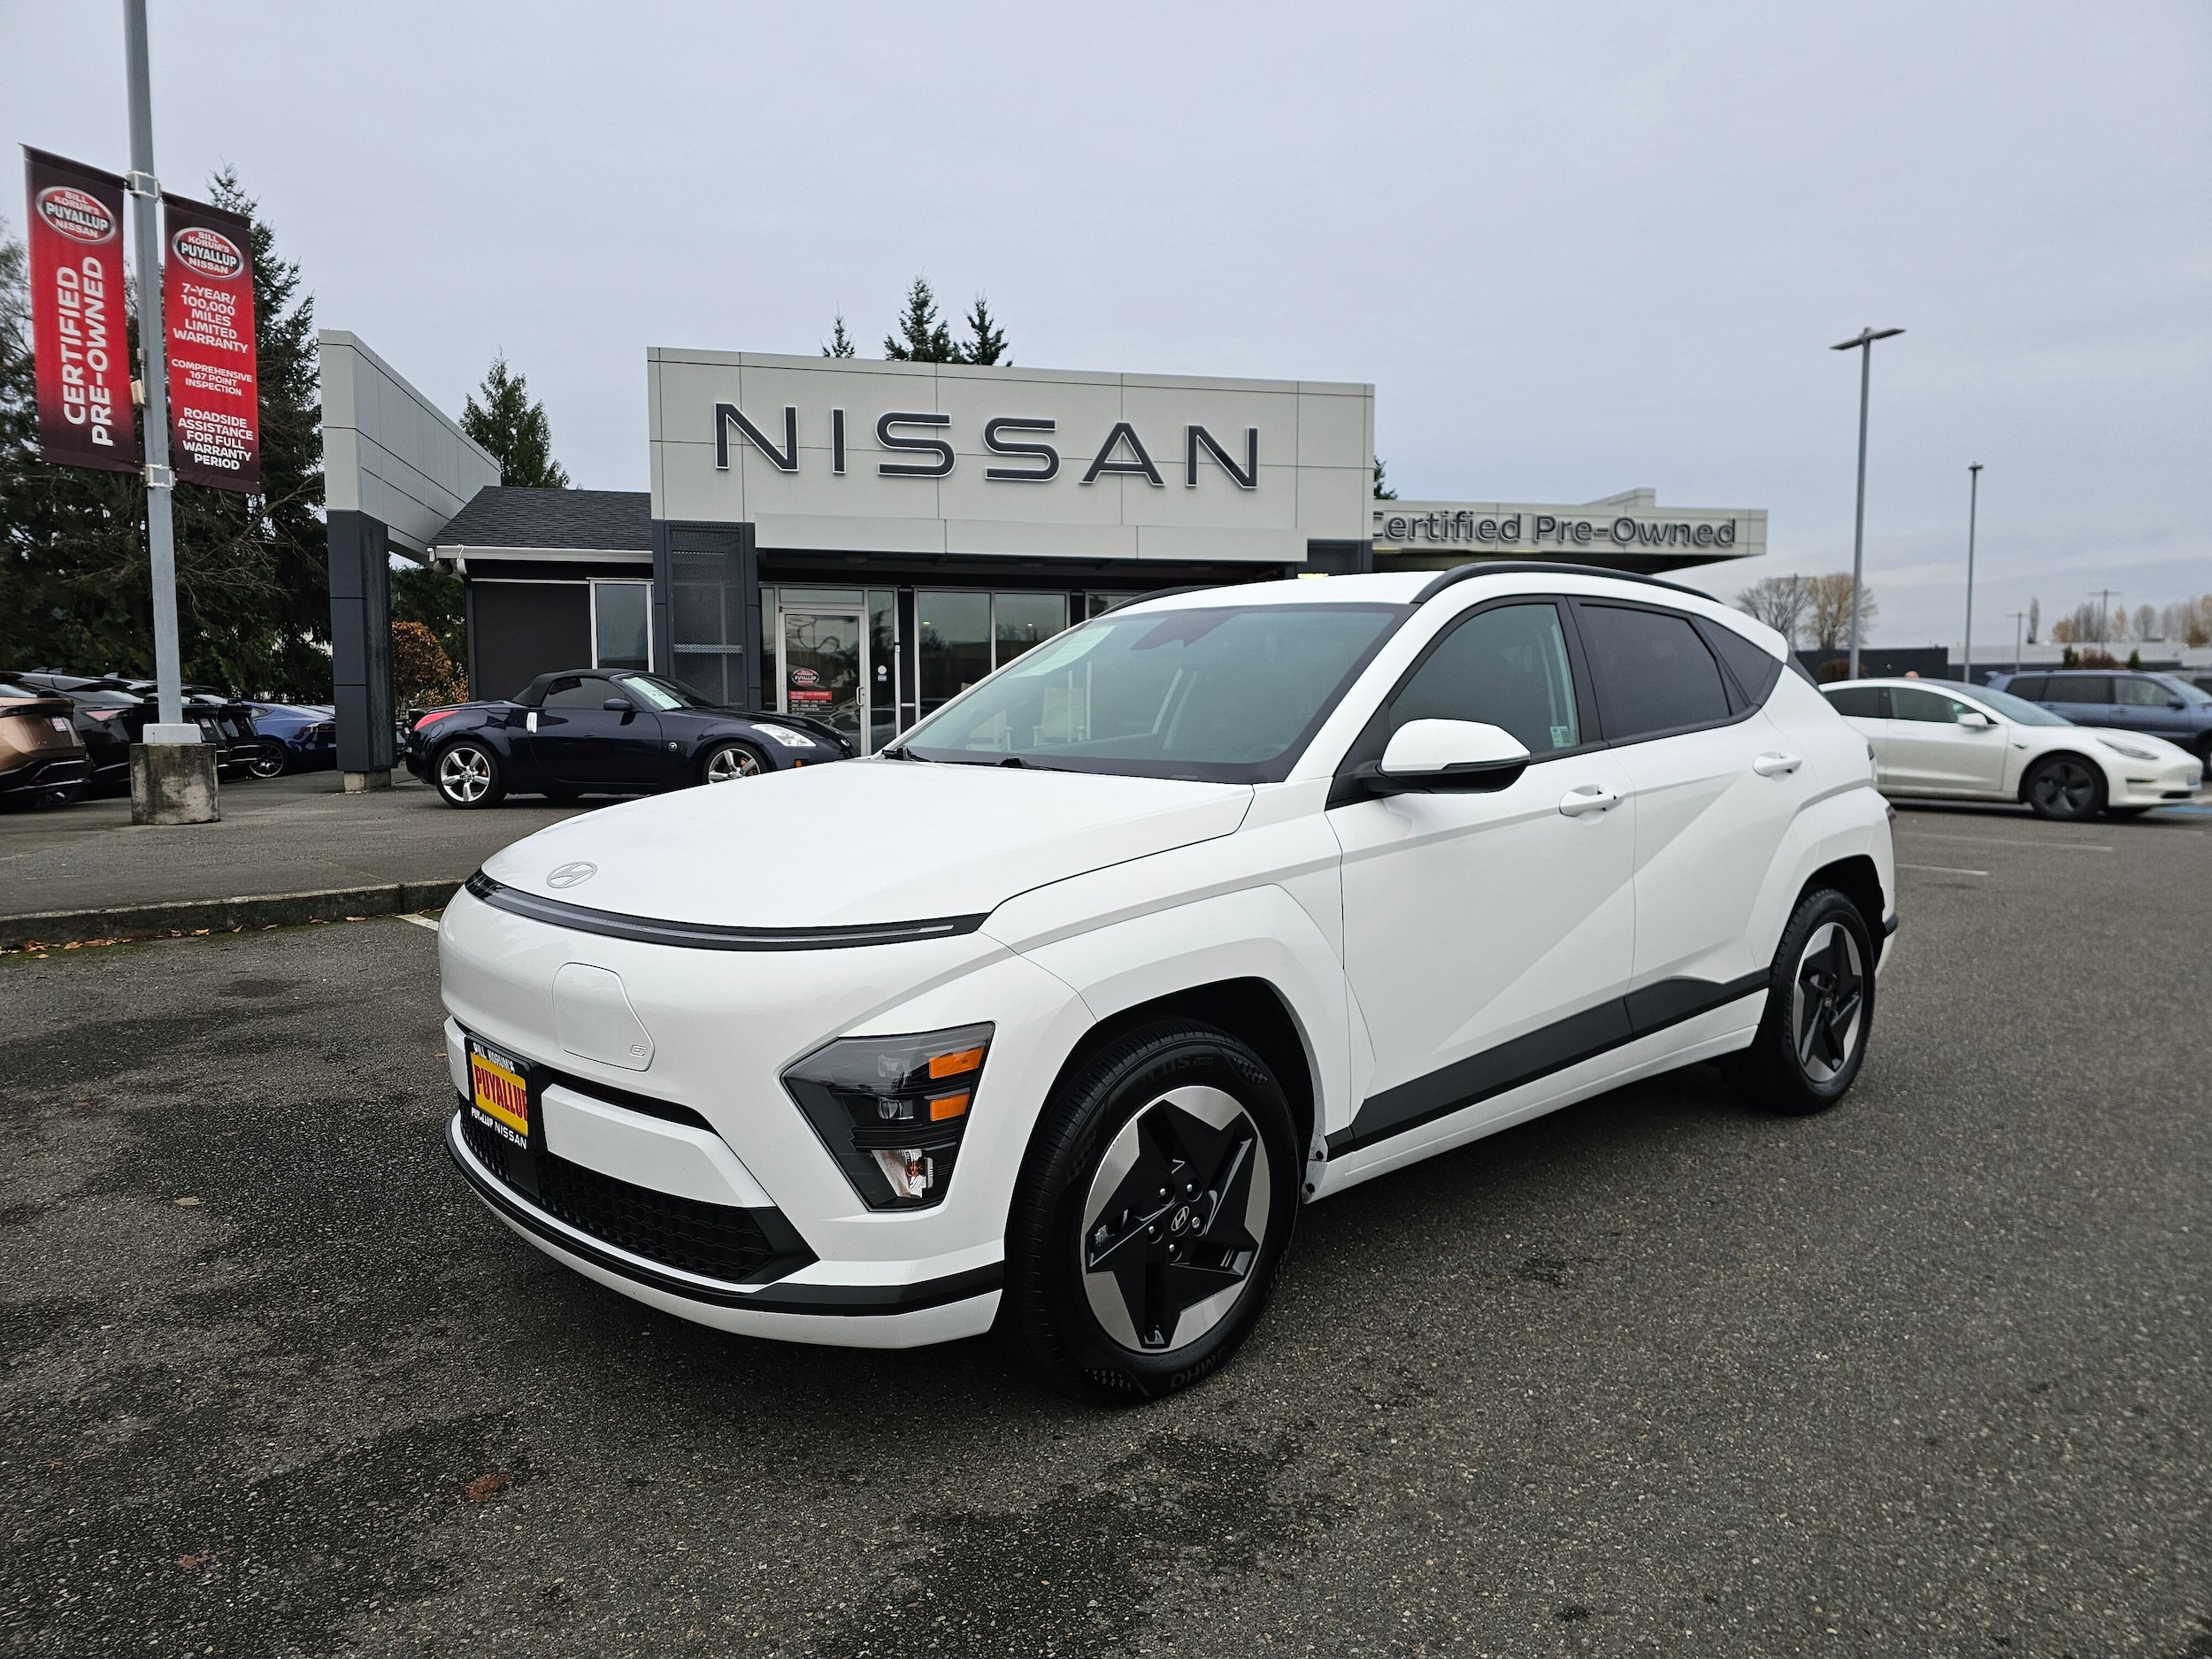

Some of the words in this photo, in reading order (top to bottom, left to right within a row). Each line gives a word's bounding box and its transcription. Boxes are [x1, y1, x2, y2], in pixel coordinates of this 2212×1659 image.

[54, 195, 100, 215] KORUM'S
[65, 190, 88, 204] BILL
[45, 202, 108, 231] PUYALLUP
[55, 218, 98, 238] NISSAN
[198, 231, 219, 243] BILL
[180, 242, 237, 267] PUYALLUP
[188, 235, 230, 253] KORUM'S
[188, 257, 228, 274] NISSAN
[182, 282, 236, 305] 7-YEAR/
[180, 295, 235, 316] 100,000
[191, 309, 232, 326] MILES
[185, 319, 237, 339] LIMITED
[57, 266, 86, 425] CERTIFIED
[173, 327, 248, 353] WARRANTY
[82, 256, 114, 447] PRE-OWNED
[171, 358, 252, 382] COMPREHENSIVE
[189, 370, 207, 380] 167
[208, 374, 238, 387] POINT
[185, 378, 242, 396] INSPECTION
[183, 407, 248, 428] ROADSIDE
[178, 418, 254, 441] ASSISTANCE
[186, 430, 213, 443] FOR
[215, 434, 245, 449] FULL
[182, 440, 252, 462] WARRANTY
[714, 401, 1259, 490] NISSAN
[195, 453, 241, 471] PERIOD
[1533, 513, 1737, 548] Pre-Owned
[495, 1120, 528, 1149] NISSAN
